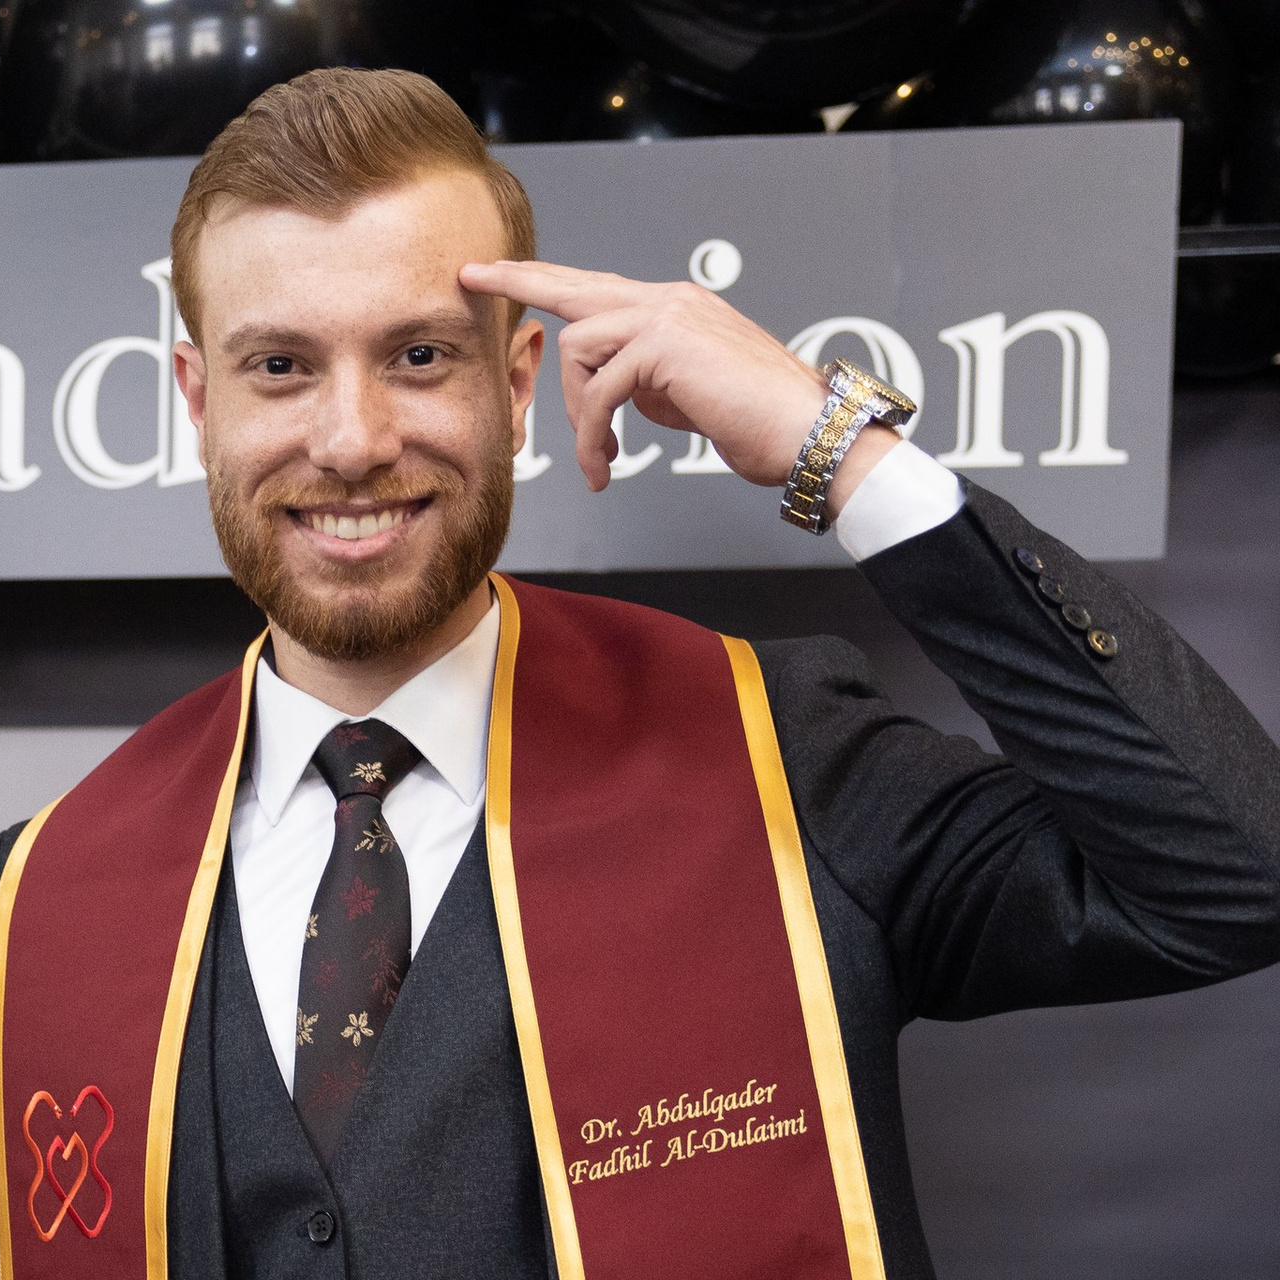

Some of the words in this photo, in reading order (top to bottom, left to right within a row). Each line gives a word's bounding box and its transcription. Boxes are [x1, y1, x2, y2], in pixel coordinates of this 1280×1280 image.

[568, 1139, 654, 1185] Fadhil
[660, 1108, 808, 1168] Al-Dulaimi
[580, 1117, 623, 1145] Dr.
[629, 1078, 778, 1136] Abdulqader
